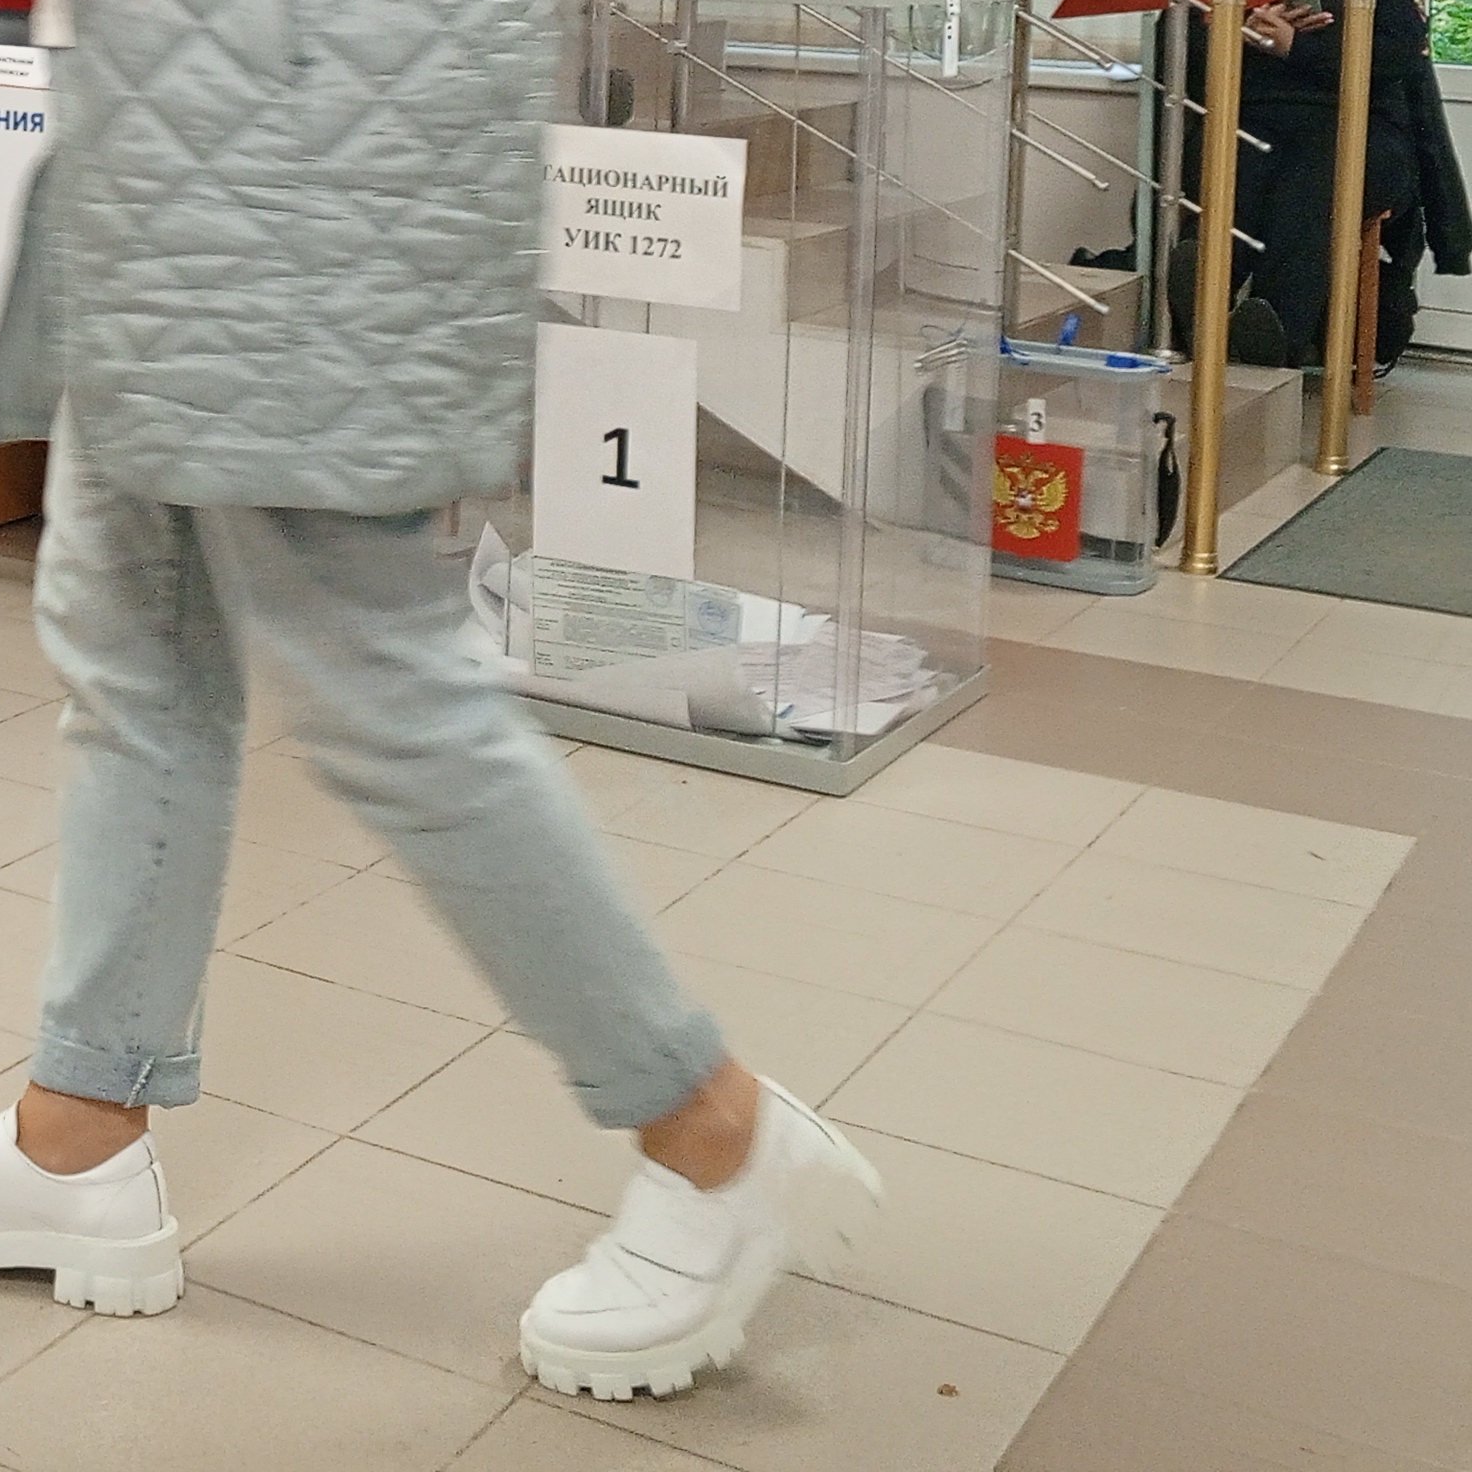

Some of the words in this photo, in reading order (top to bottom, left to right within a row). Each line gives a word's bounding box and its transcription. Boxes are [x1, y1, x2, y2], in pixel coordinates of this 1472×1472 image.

[585, 197, 662, 222] ЯЩИК
[563, 227, 623, 253] УИК
[629, 235, 683, 259] 1272
[1029, 411, 1044, 432] 3
[601, 427, 641, 489] 1
